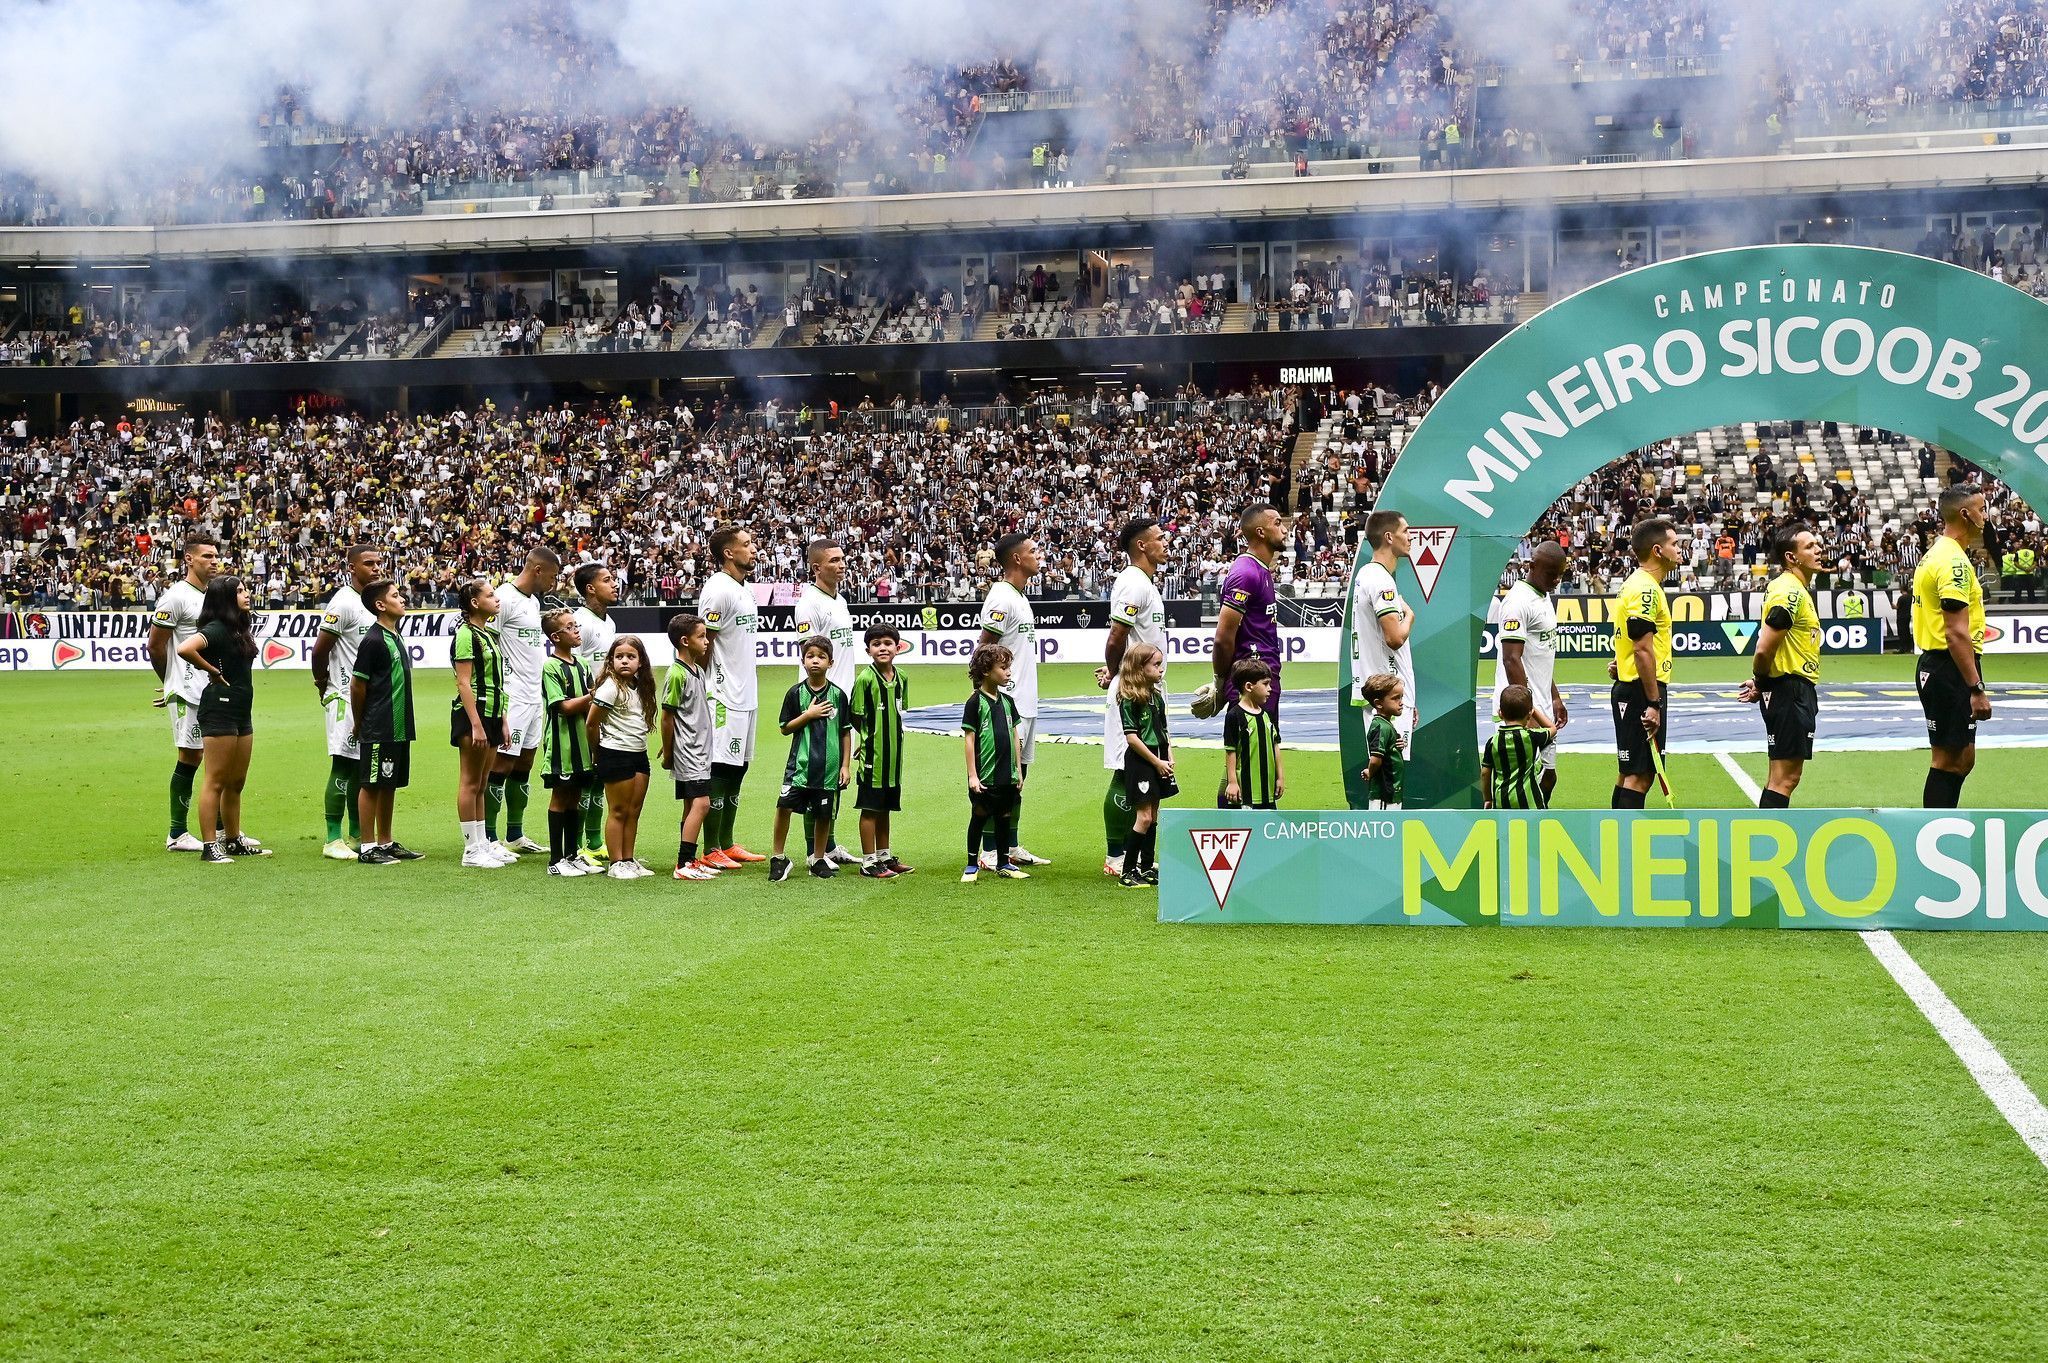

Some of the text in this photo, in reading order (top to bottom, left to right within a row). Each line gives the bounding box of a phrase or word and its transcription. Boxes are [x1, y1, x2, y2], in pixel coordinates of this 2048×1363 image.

[1655, 278, 1897, 319] CAMPEONATO
[1280, 366, 1334, 384] BRAHMA
[1443, 315, 2048, 519] MINEIRO SICOOB 20
[1234, 593, 1247, 602] BH
[157, 612, 169, 620] BH
[1040, 615, 1064, 625] MRV
[798, 623, 809, 632] BH
[1504, 620, 1519, 630] BH
[1701, 641, 1721, 651] 2024
[1262, 821, 1396, 840] CAMPEONATO
[1200, 833, 1241, 850] FMF
[1402, 817, 1898, 919] MINEIRO
